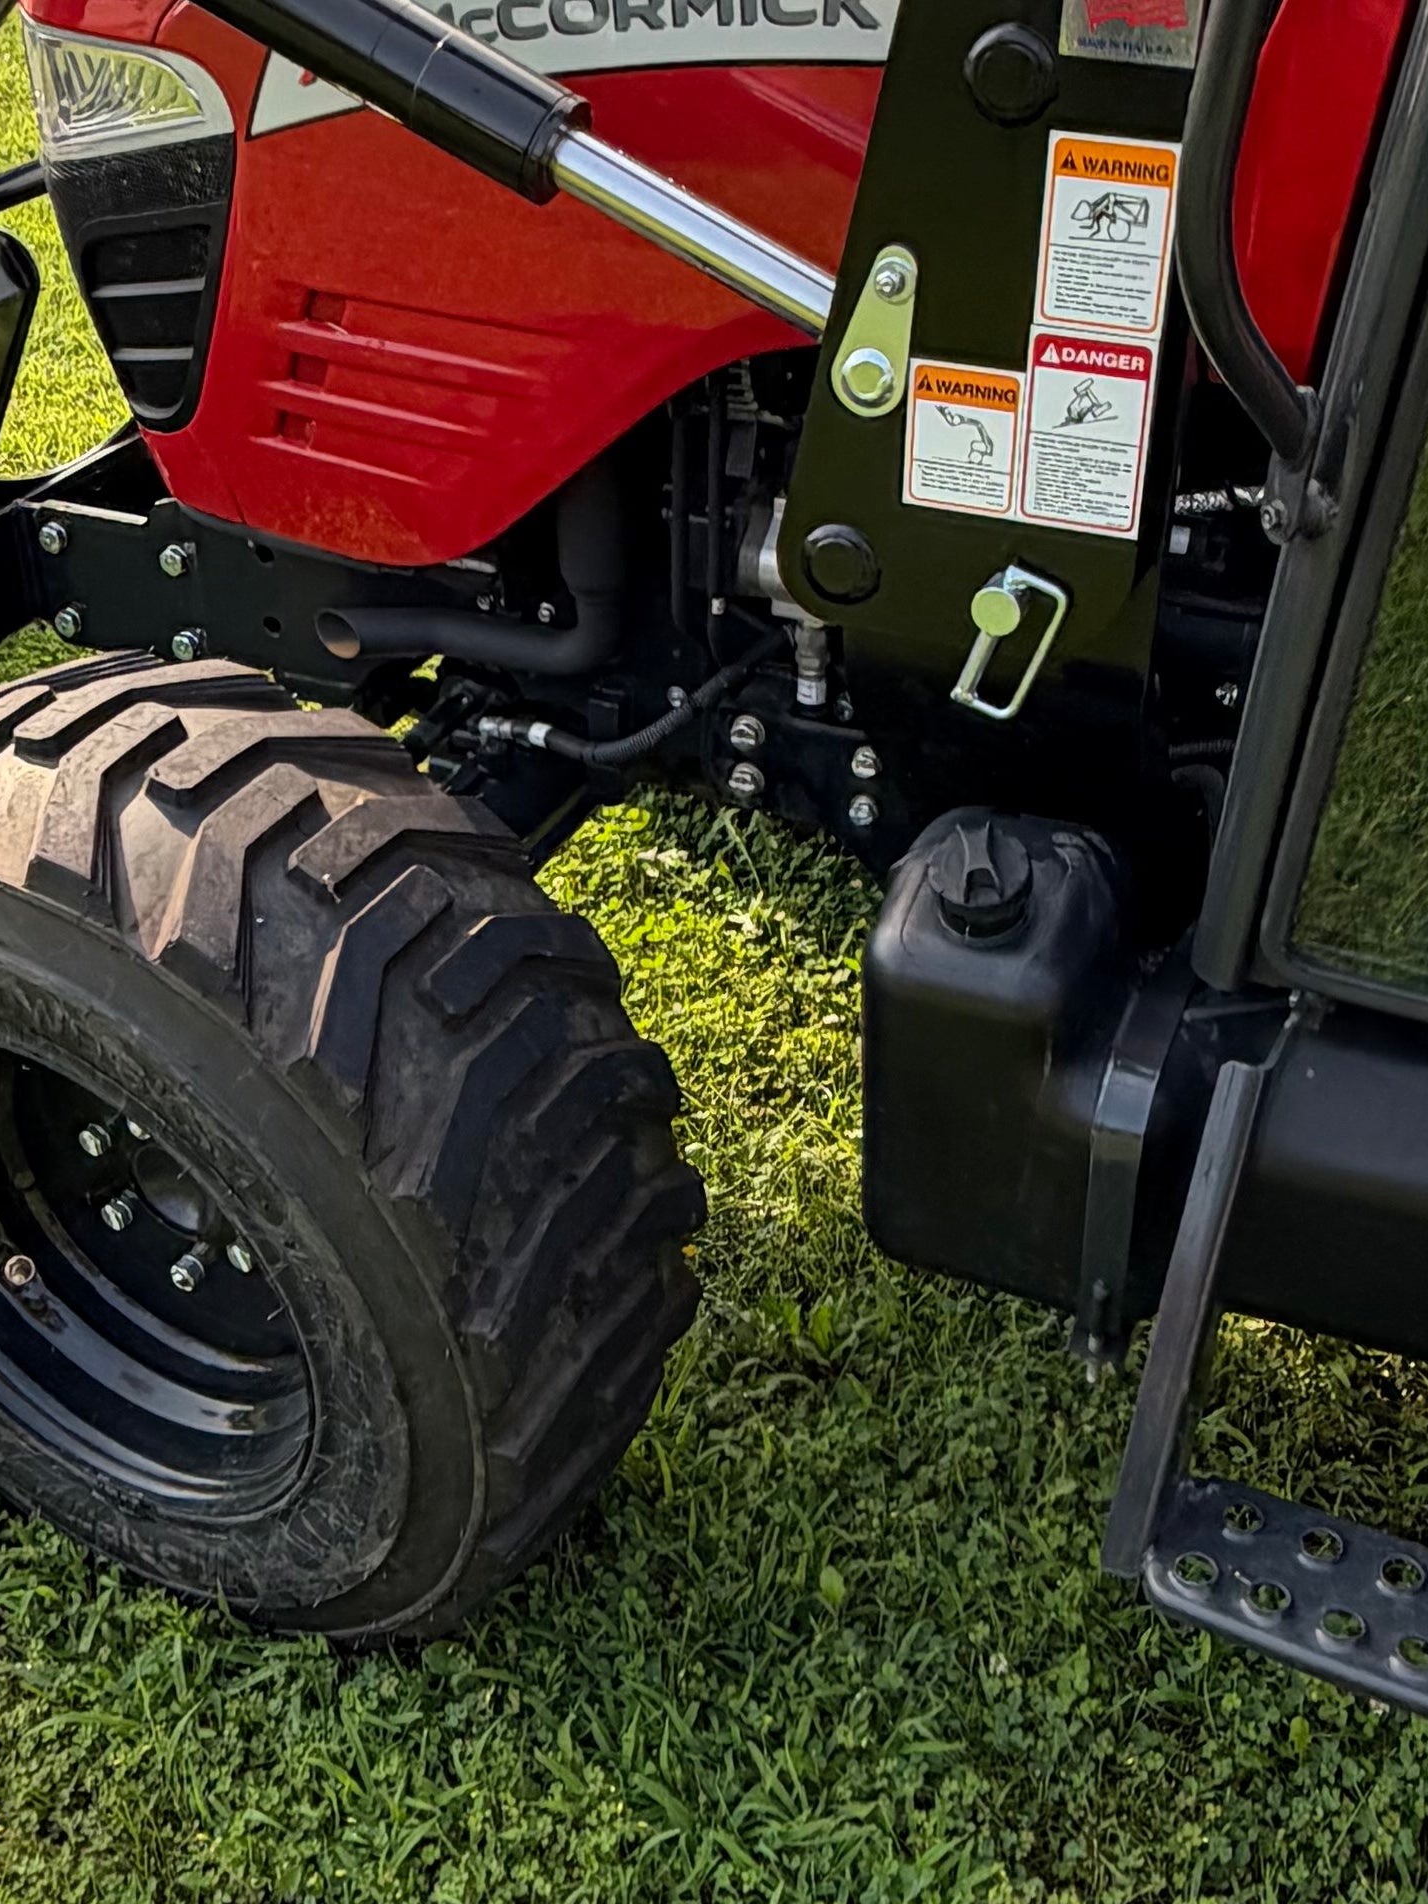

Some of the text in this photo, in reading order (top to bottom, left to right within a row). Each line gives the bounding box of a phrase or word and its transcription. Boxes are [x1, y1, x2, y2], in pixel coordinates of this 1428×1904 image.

[1082, 156, 1169, 182] WARNING
[1061, 346, 1146, 372] DANGER
[935, 378, 1017, 404] WARNING
